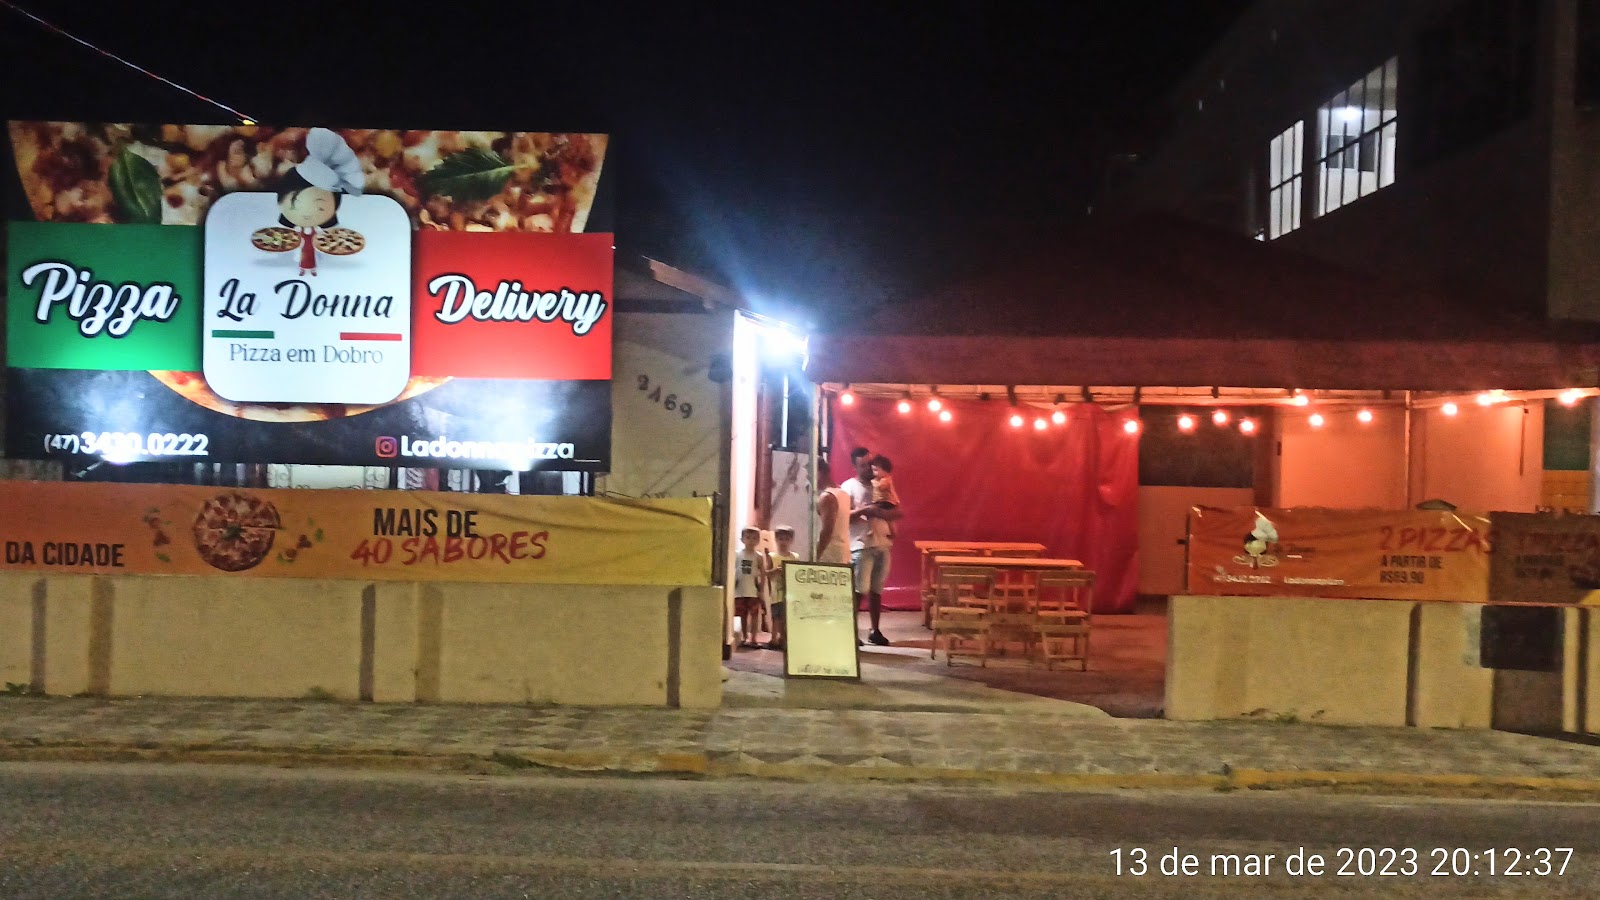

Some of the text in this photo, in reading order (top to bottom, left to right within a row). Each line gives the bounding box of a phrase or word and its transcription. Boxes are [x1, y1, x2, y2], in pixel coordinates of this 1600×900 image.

[22, 262, 179, 336] Pizza
[216, 278, 394, 322] La Donna
[429, 275, 606, 335] Delivery
[230, 343, 384, 364] Pizza em Dobro
[374, 508, 479, 538] MAIS DE
[1380, 525, 1393, 551] 2
[5, 541, 125, 568] DA CIDADE
[351, 531, 549, 567] 40 SABORES
